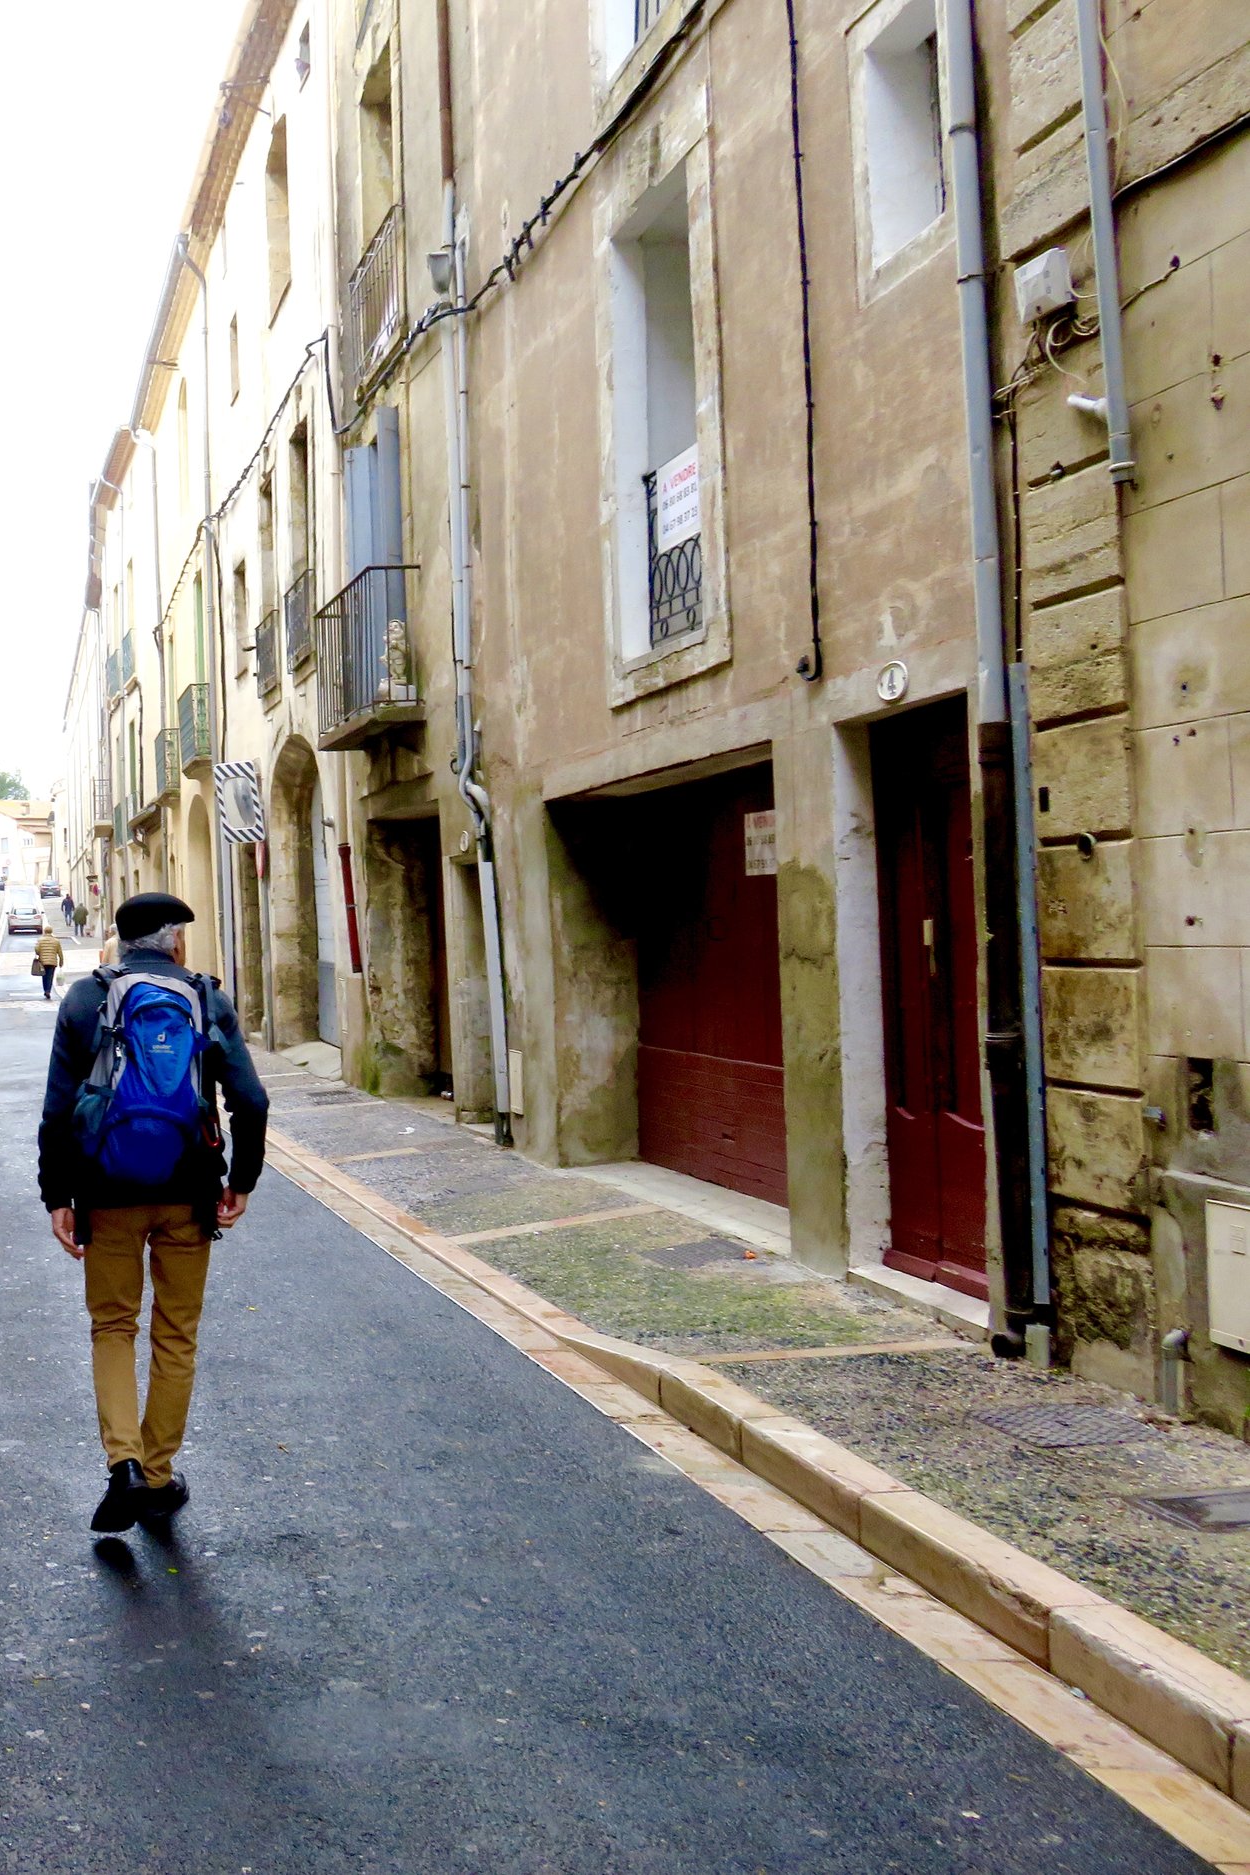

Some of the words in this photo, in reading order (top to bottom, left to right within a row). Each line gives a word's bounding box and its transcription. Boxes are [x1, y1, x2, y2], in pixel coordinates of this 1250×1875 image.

[662, 482, 668, 495] A
[669, 462, 697, 489] VENDRE
[887, 669, 897, 697] 4
